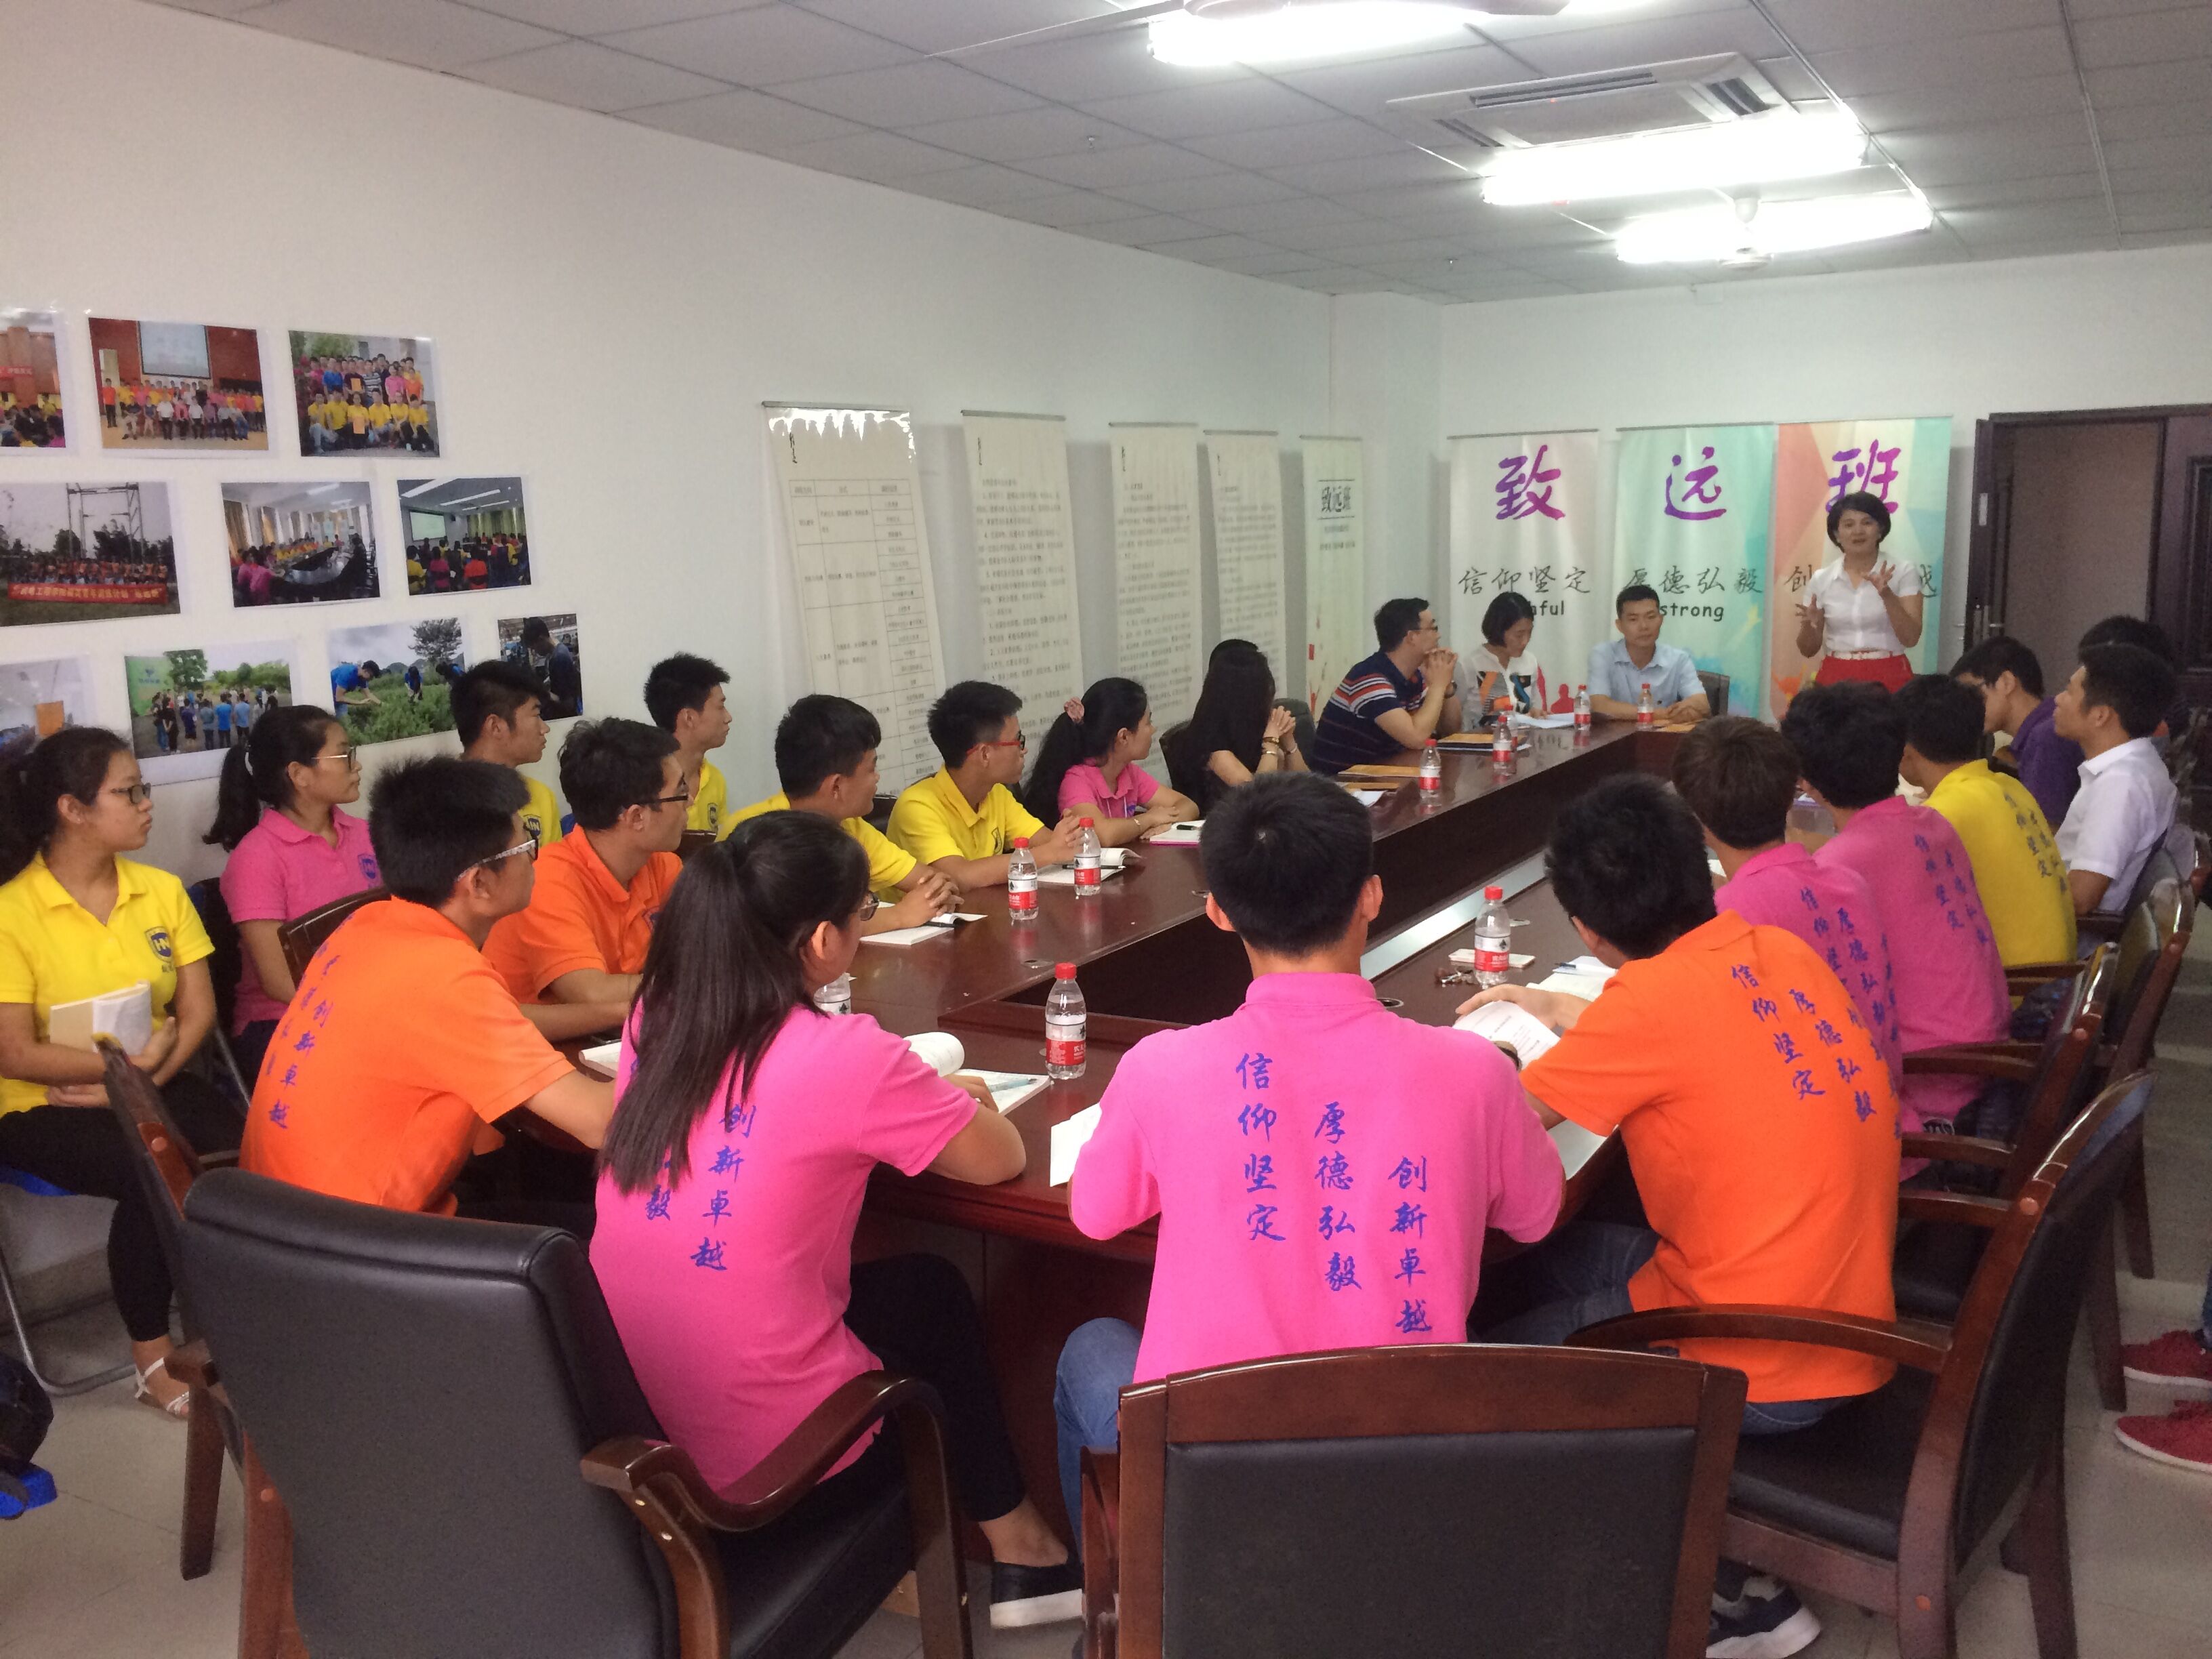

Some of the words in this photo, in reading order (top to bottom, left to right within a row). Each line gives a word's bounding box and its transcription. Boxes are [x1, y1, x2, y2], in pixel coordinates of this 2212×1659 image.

[1494, 444, 1565, 521] 致
[1664, 446, 1727, 520] 远
[1825, 438, 1902, 514] 班
[1458, 565, 1591, 594] 信仰坚定
[1660, 602, 1725, 622] strong
[1731, 964, 1826, 1101] 信仰坚定
[1235, 1052, 1287, 1242] 信仰坚定
[1313, 1101, 1363, 1292] 厚德弘毅
